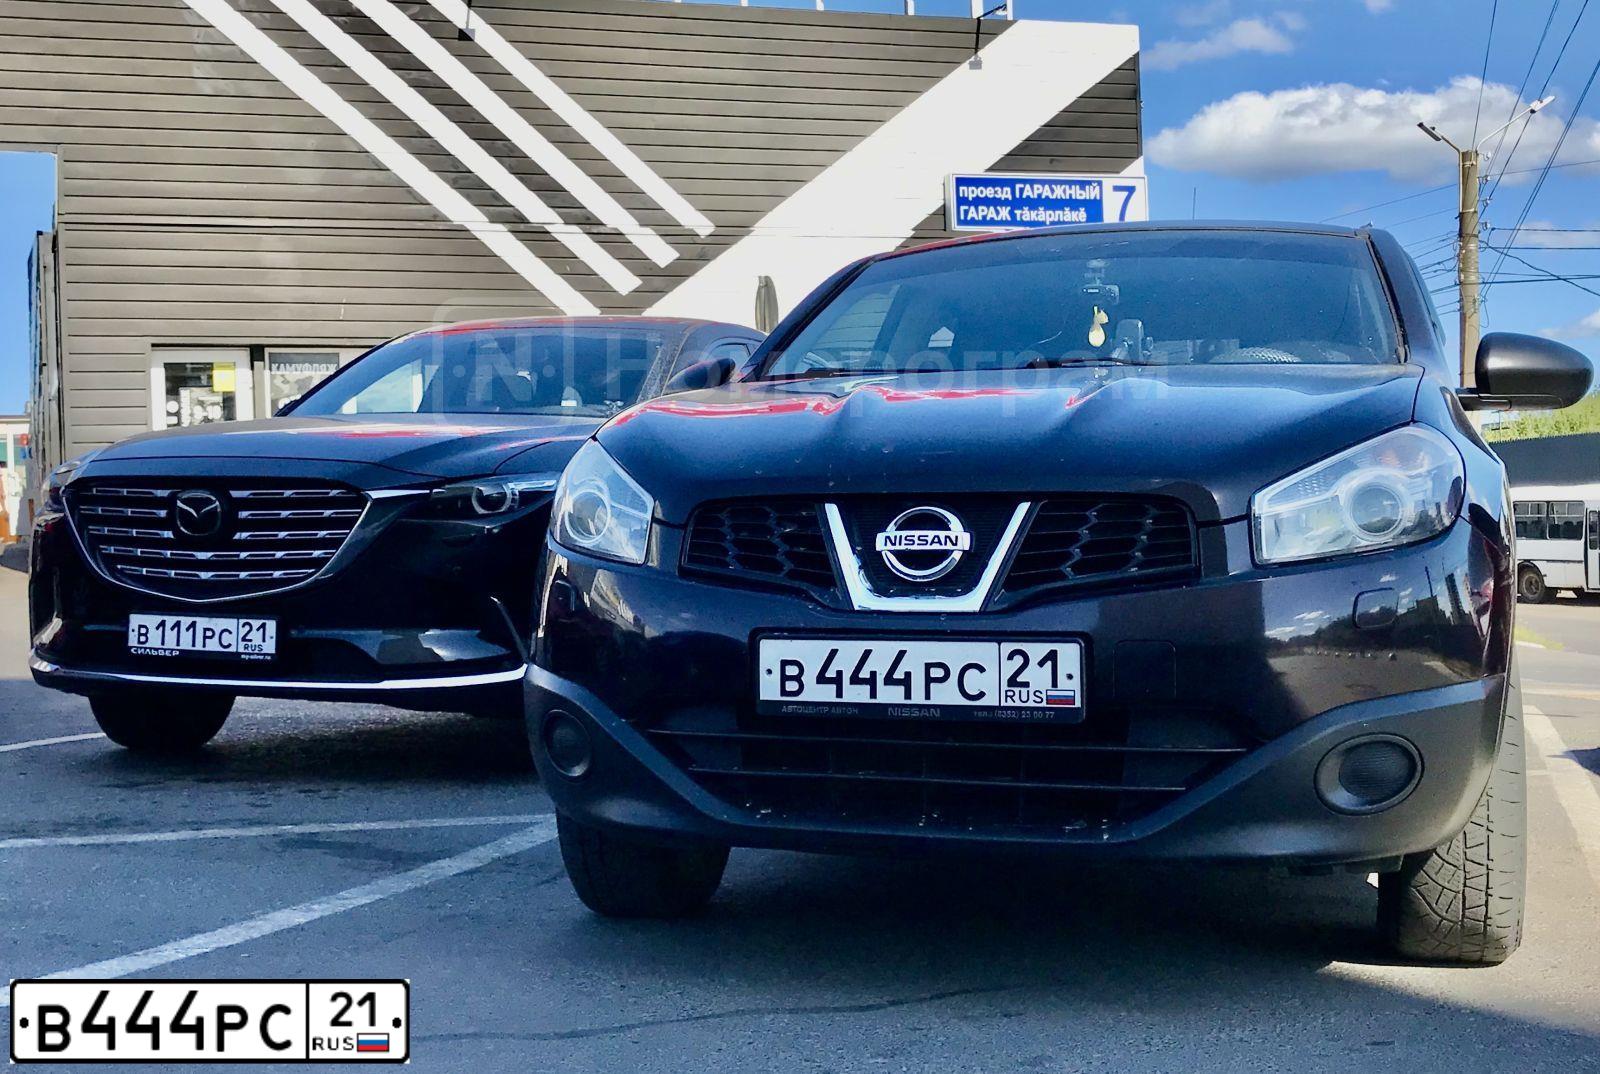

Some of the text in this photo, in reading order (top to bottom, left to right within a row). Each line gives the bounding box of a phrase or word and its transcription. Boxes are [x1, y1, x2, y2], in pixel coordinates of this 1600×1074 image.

[959, 182, 1101, 201] проезд ГАРАЖНЫЙ
[1112, 185, 1137, 222] 7
[959, 205, 1011, 221] ГАРАЖ
[884, 534, 959, 547] NISSAN
[241, 621, 267, 643] 21
[130, 647, 180, 657] СИЛЬВЕР
[243, 643, 264, 652] RUS
[779, 648, 988, 701] В444РС
[1006, 648, 1059, 688] 21
[1004, 689, 1044, 704] RUS
[781, 705, 829, 714] АВТОЦЕНТР
[888, 706, 940, 717] NISSAN
